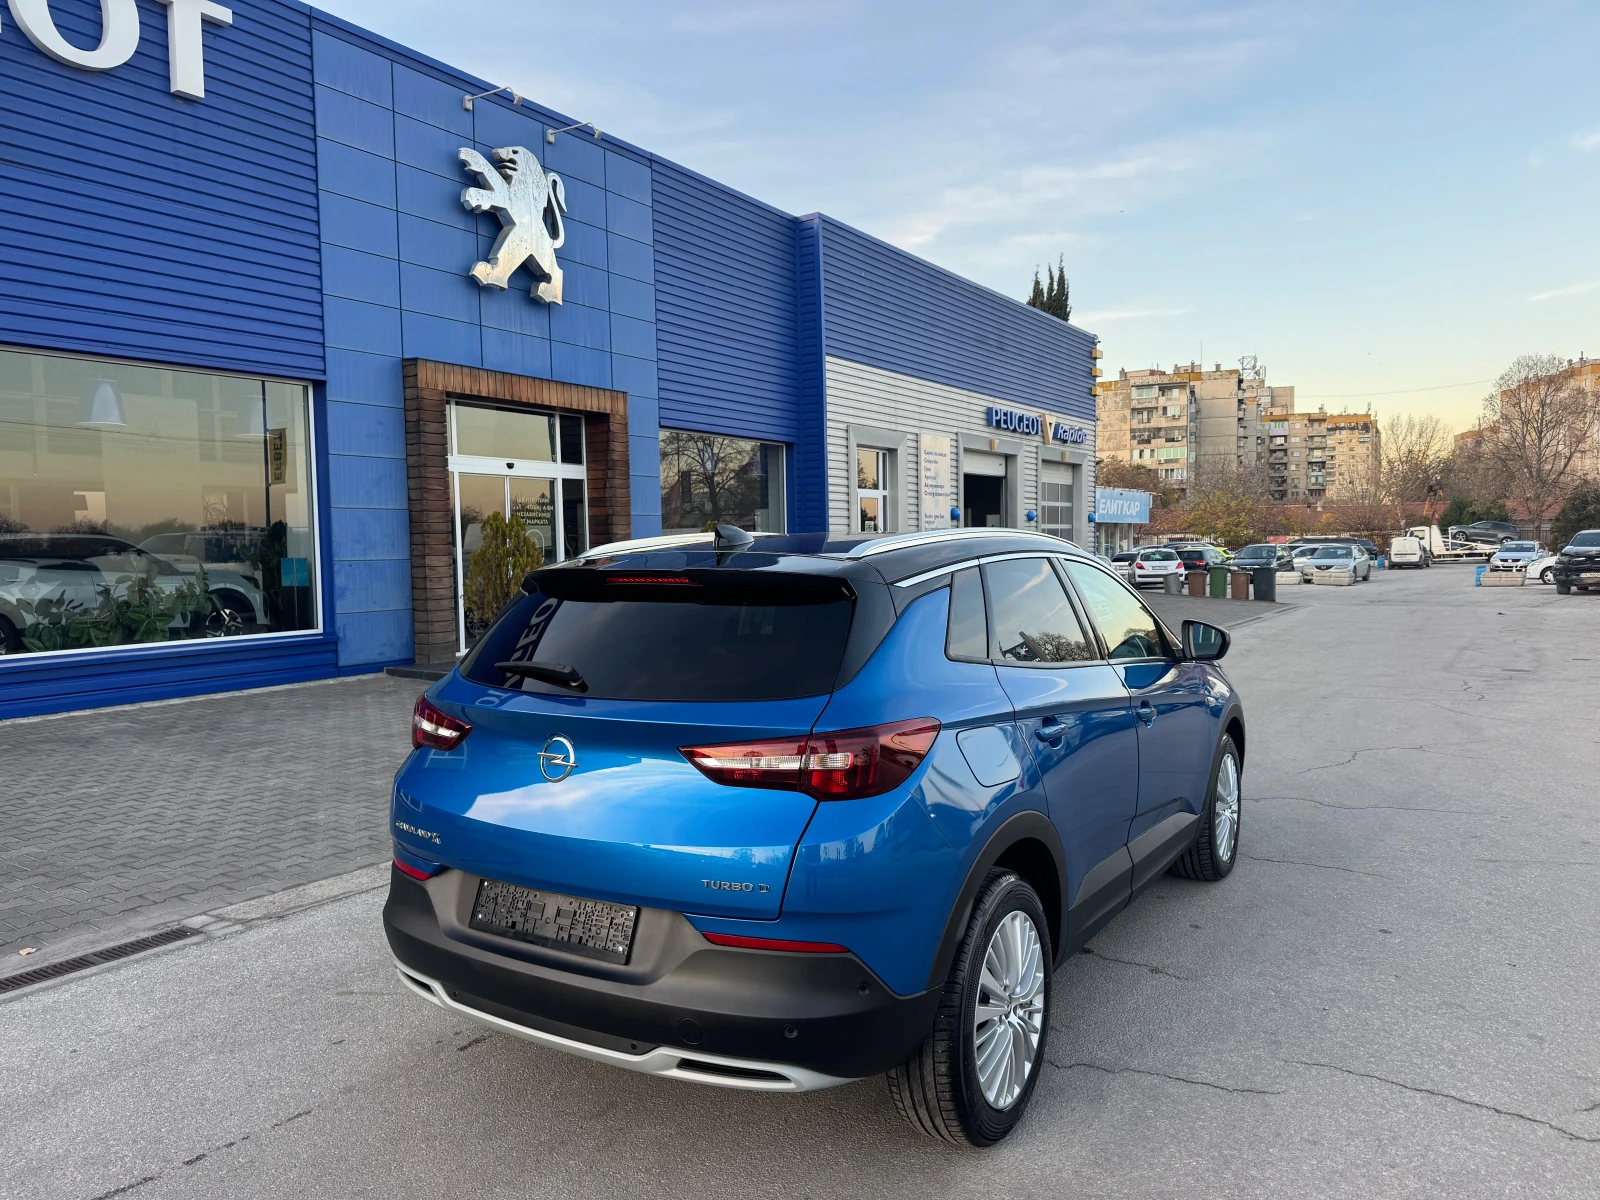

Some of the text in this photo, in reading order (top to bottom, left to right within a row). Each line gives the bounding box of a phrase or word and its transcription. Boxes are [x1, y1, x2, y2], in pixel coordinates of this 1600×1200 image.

[991, 407, 1088, 444] PEUGEOT Rapide
[701, 879, 770, 893] TURBO D
